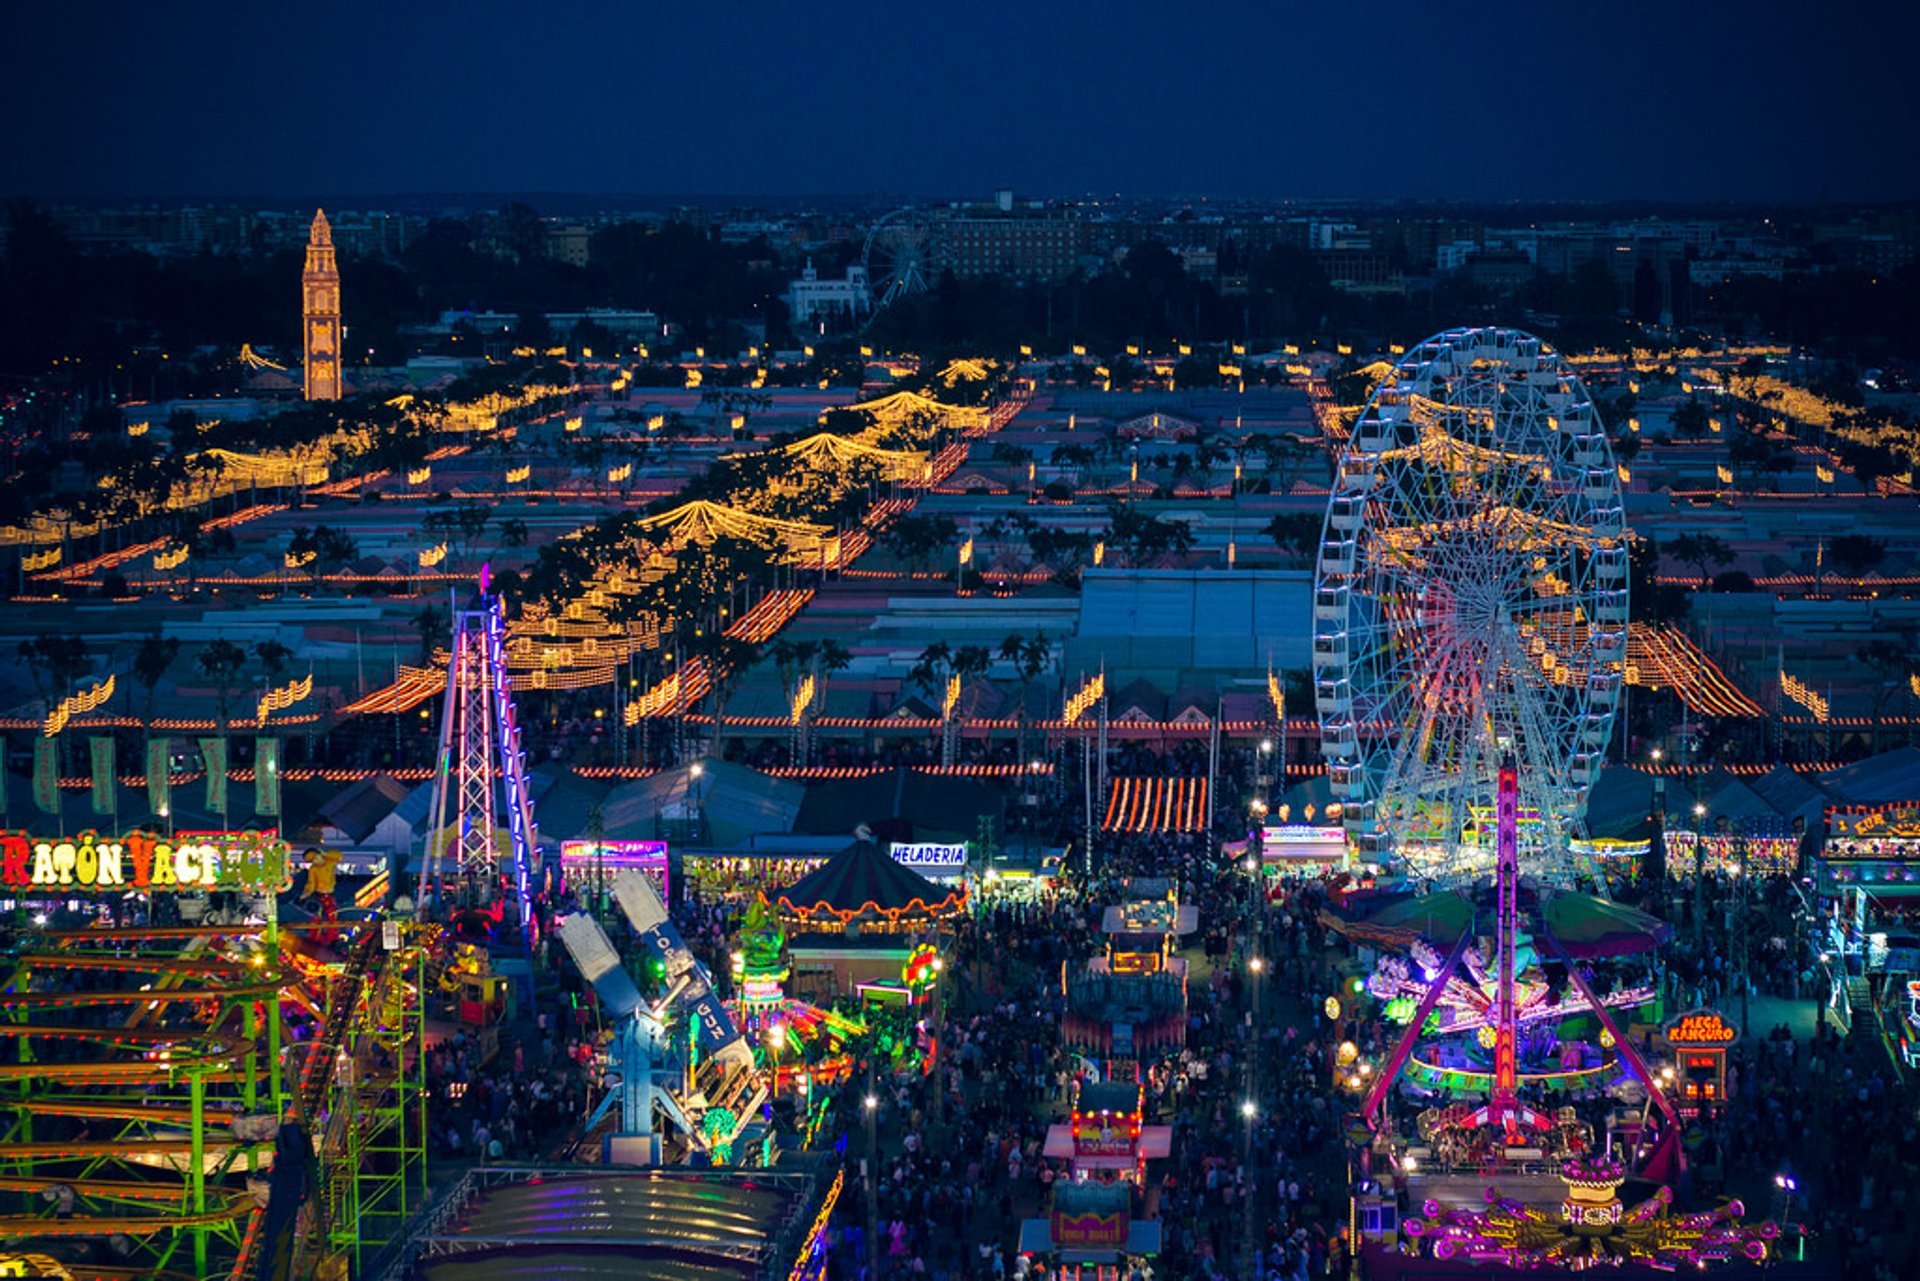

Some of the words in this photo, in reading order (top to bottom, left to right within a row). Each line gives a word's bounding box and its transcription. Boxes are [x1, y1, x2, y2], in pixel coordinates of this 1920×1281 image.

[893, 847, 963, 863] HELADERIA
[648, 921, 675, 959] TOP
[697, 1003, 725, 1040] GUN
[1681, 1015, 1722, 1029] MEGA
[1668, 1027, 1734, 1041] KANGURO
